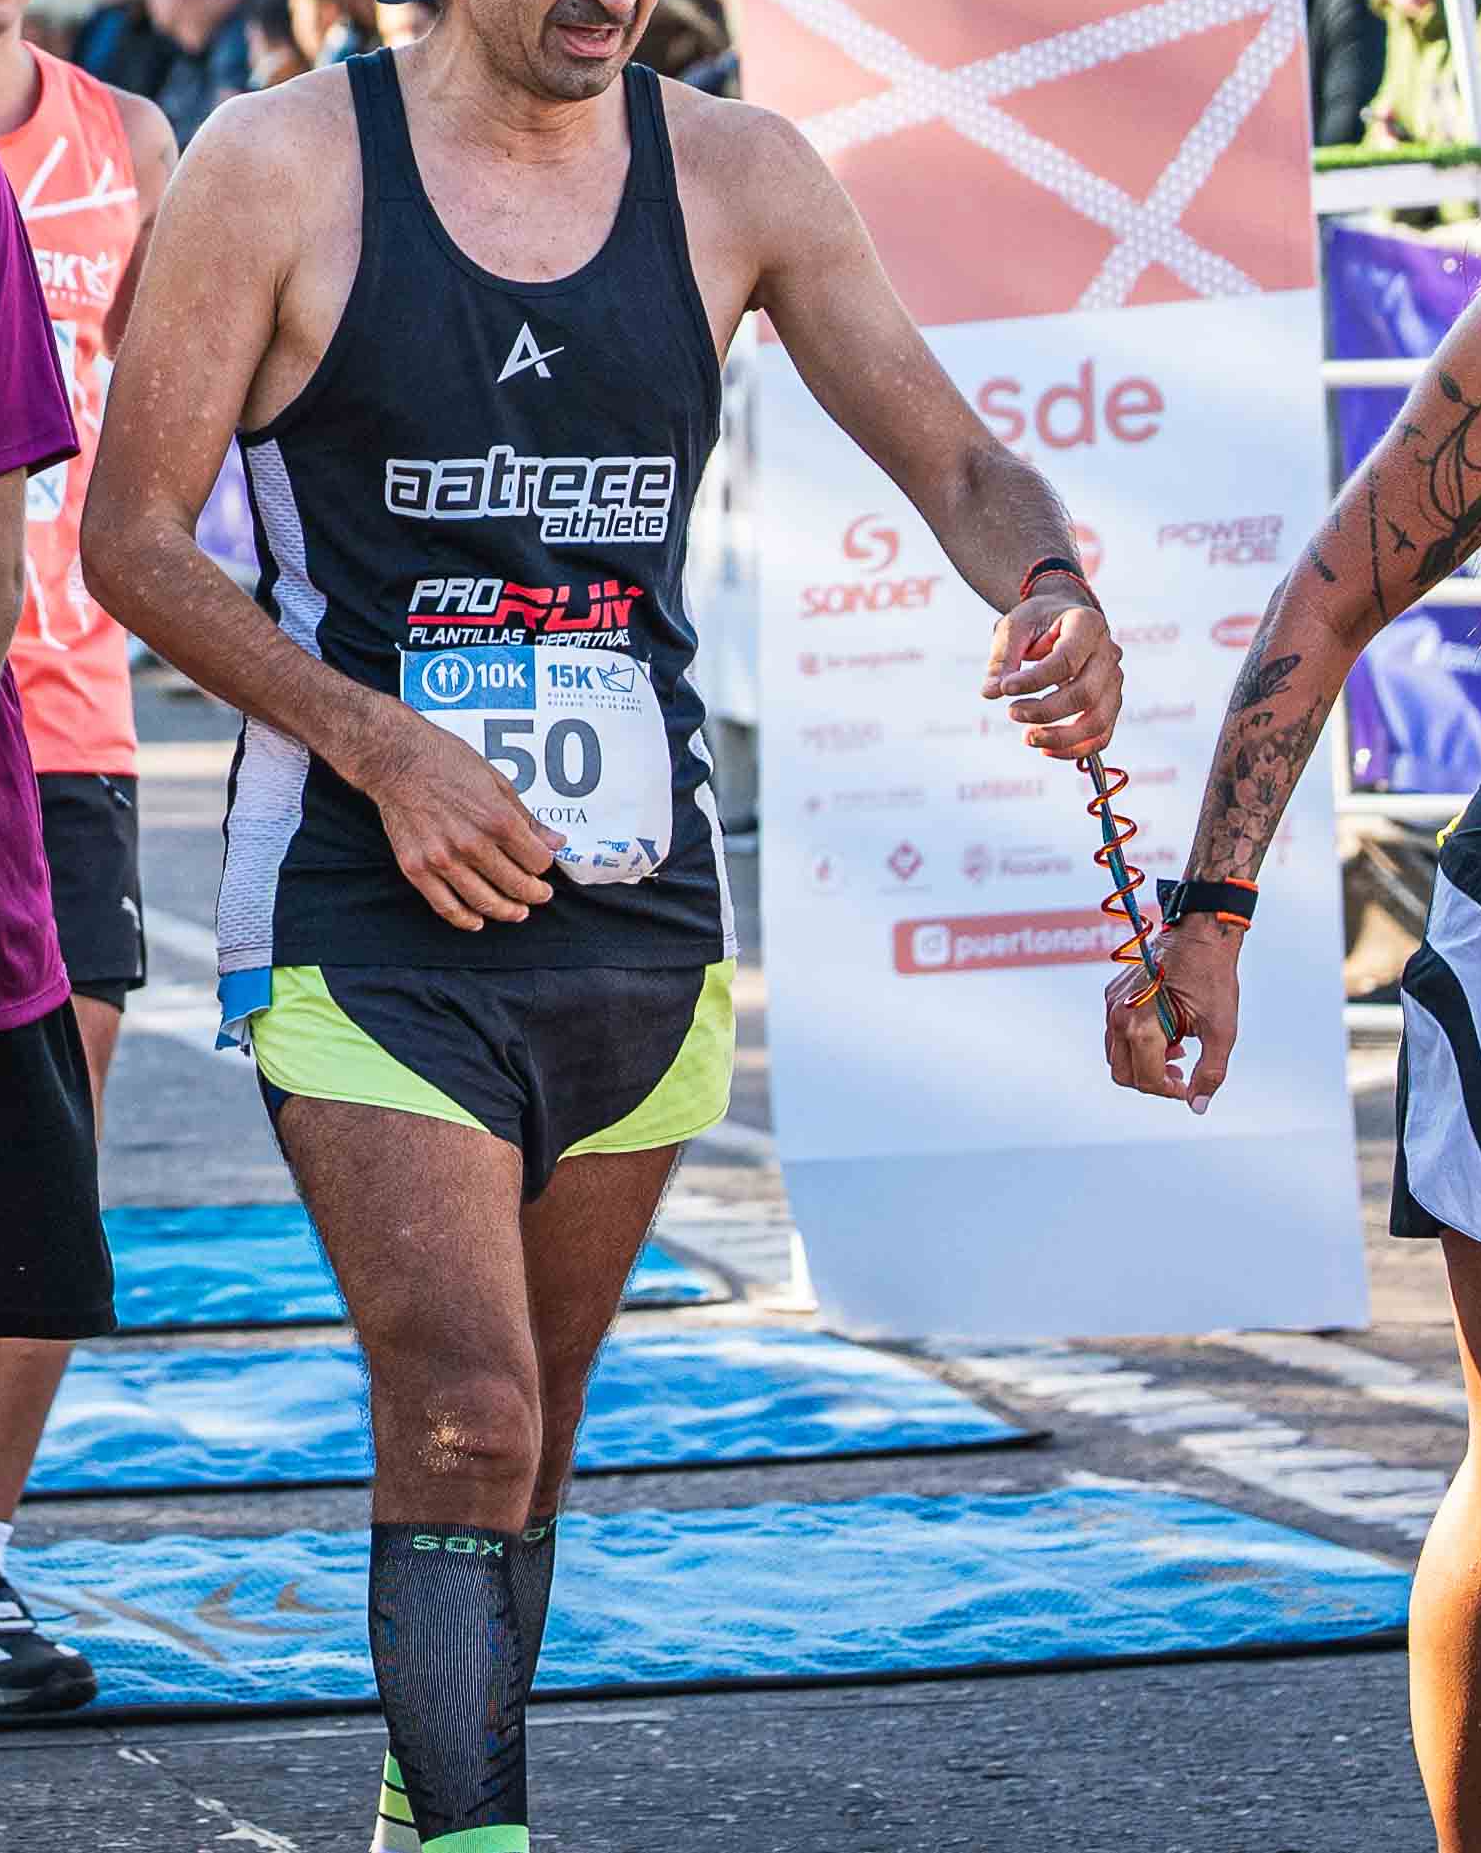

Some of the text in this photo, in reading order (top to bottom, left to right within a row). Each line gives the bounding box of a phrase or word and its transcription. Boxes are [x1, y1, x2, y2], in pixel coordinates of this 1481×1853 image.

[35, 248, 78, 288] 5K
[978, 358, 1166, 449] sde
[385, 445, 676, 519] aatrece
[540, 504, 668, 544] athlete
[409, 626, 526, 646] PLANTILLAS
[476, 663, 528, 689] 10K
[547, 663, 594, 690] 15K
[484, 718, 602, 798] 50
[533, 806, 588, 824] COTA
